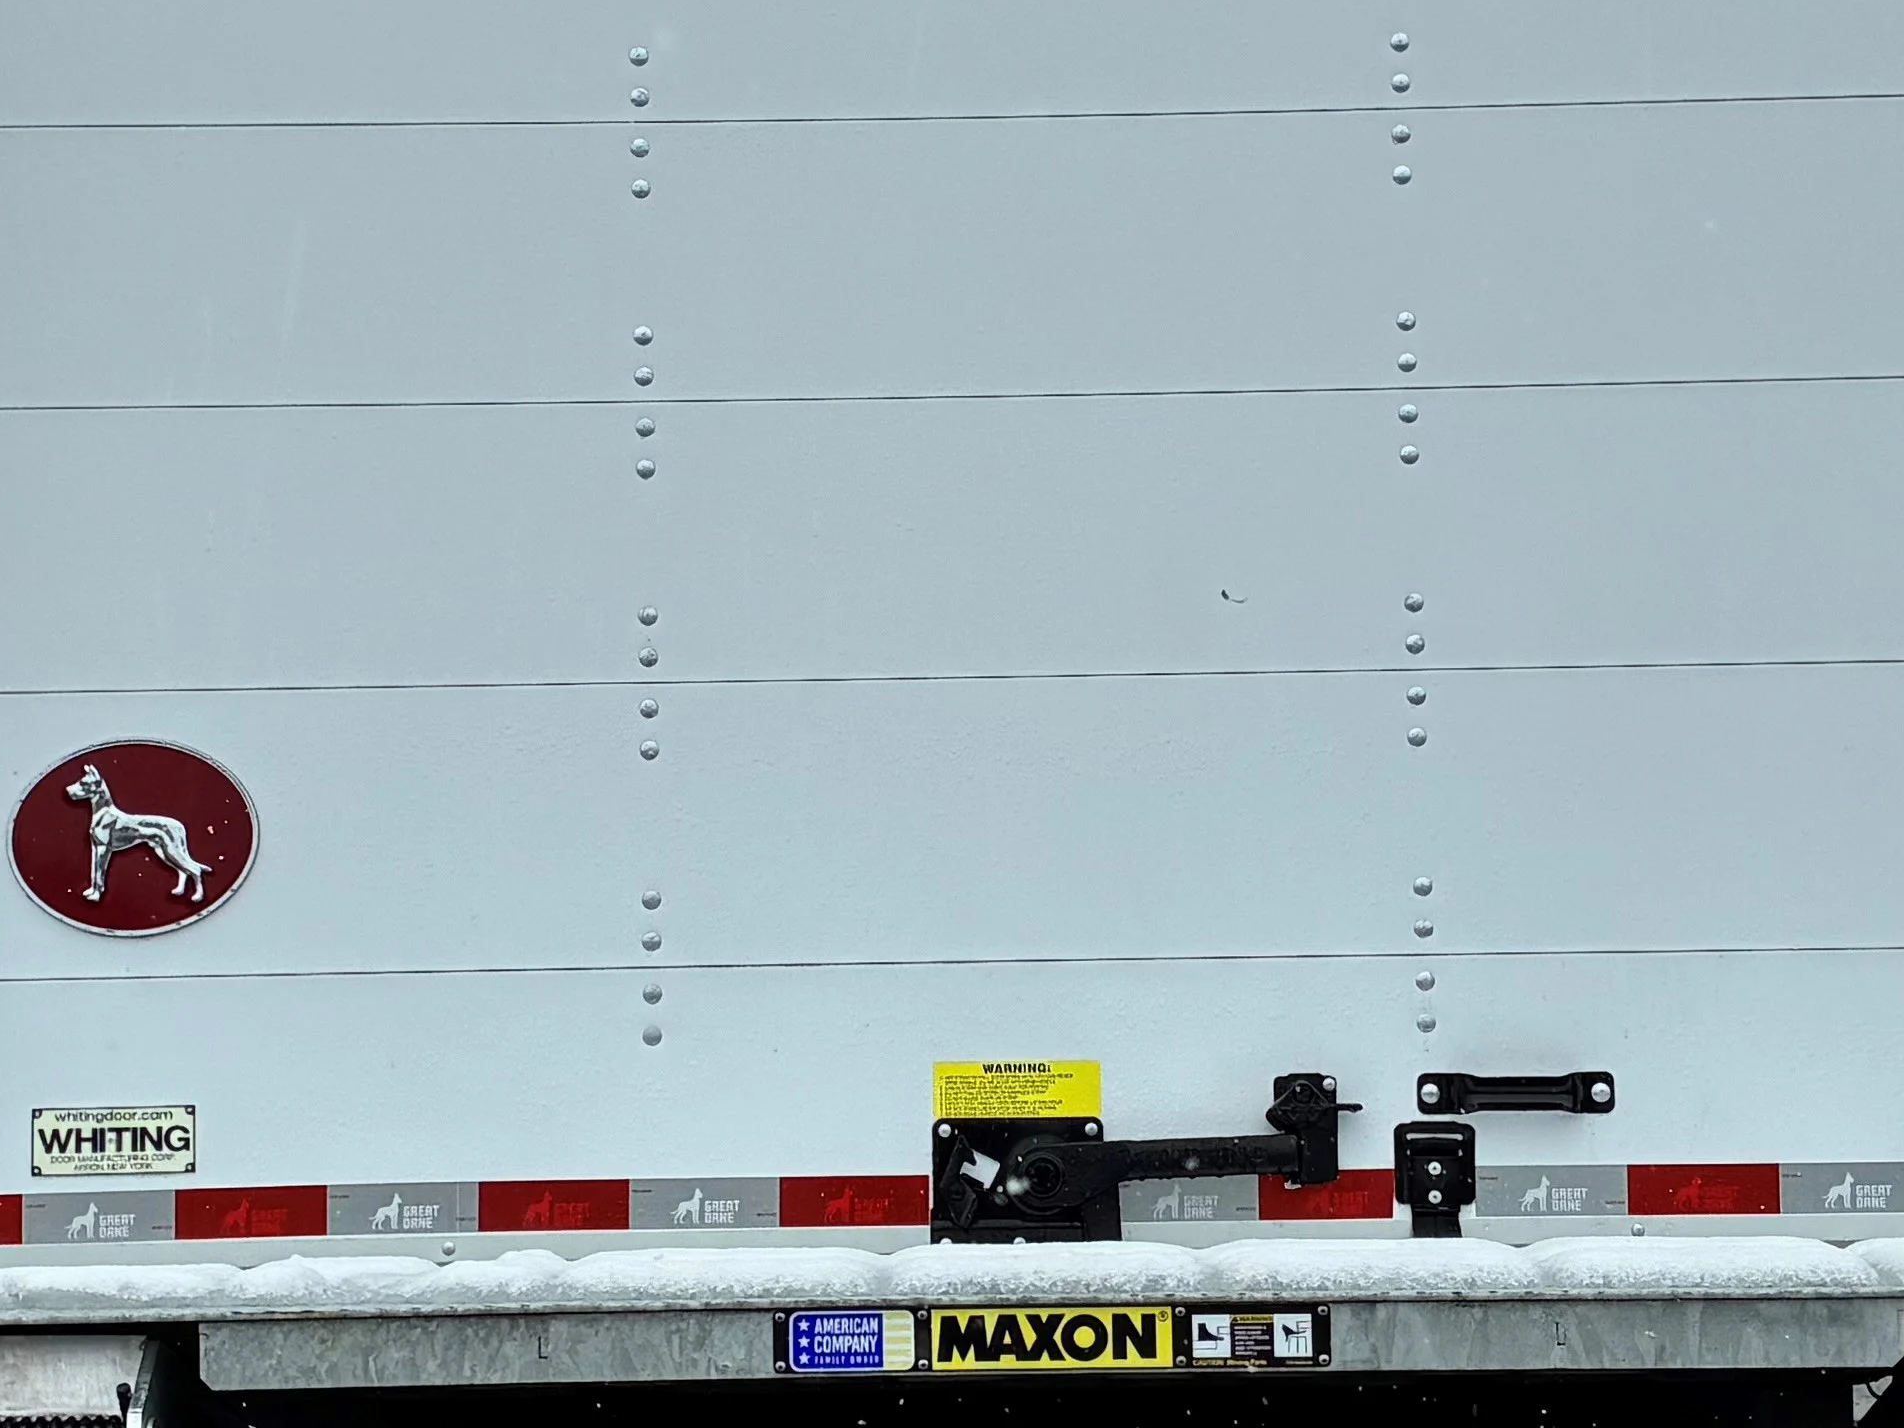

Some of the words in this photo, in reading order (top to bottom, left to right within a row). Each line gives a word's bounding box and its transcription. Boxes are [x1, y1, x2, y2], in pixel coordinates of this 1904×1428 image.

[54, 1109, 173, 1123] whitingdoor.com
[38, 1125, 190, 1154] WHITING
[1551, 1187, 1588, 1199] GREAT
[1856, 1185, 1892, 1196] GREAT
[704, 1200, 741, 1212] GREAT
[1183, 1195, 1220, 1207] GREAT
[402, 1204, 440, 1217] GREAT
[99, 1214, 136, 1225] GREAT
[814, 1317, 879, 1334] AMERICAN
[814, 1335, 878, 1353] COMPANY
[937, 1313, 1158, 1363] MAXON
